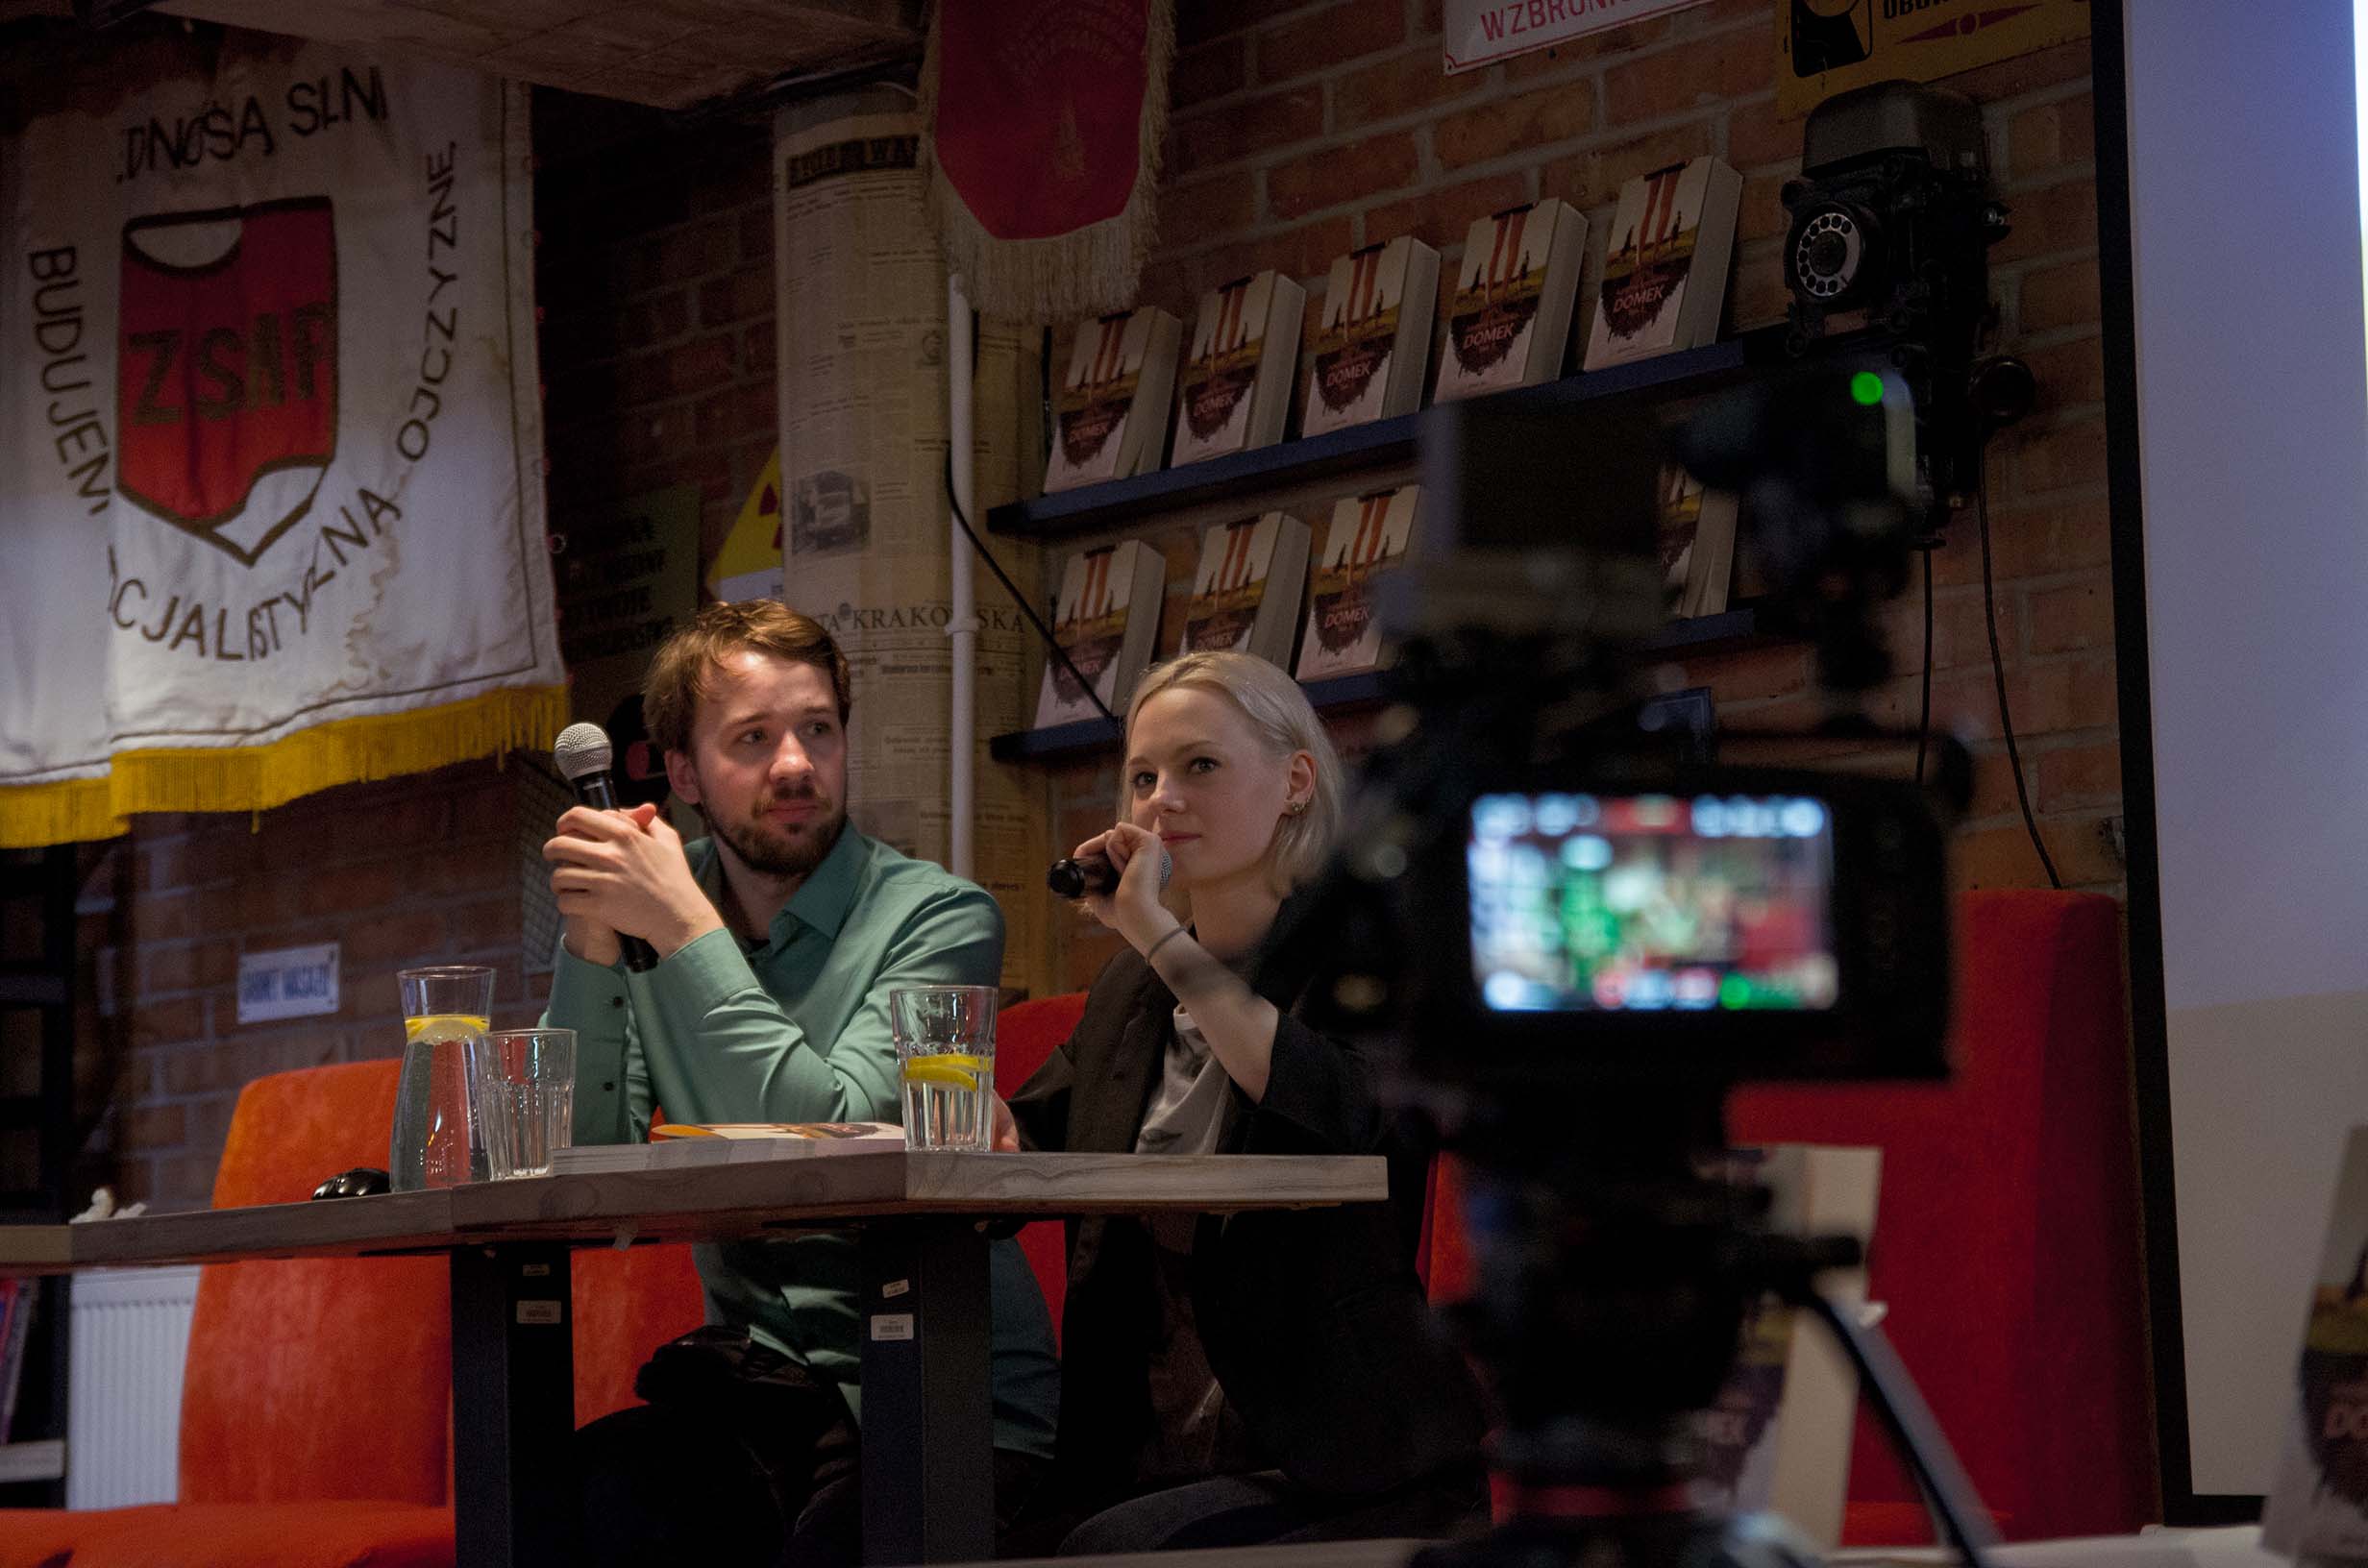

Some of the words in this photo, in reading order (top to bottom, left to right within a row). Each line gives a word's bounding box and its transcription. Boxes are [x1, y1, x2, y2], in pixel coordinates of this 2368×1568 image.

[1614, 283, 1664, 313] DOMEK
[1463, 322, 1515, 350] DOMEK
[1326, 360, 1371, 387] DOMEK
[851, 605, 1025, 633] KRAKOSKA
[1325, 605, 1369, 628] DOMEK
